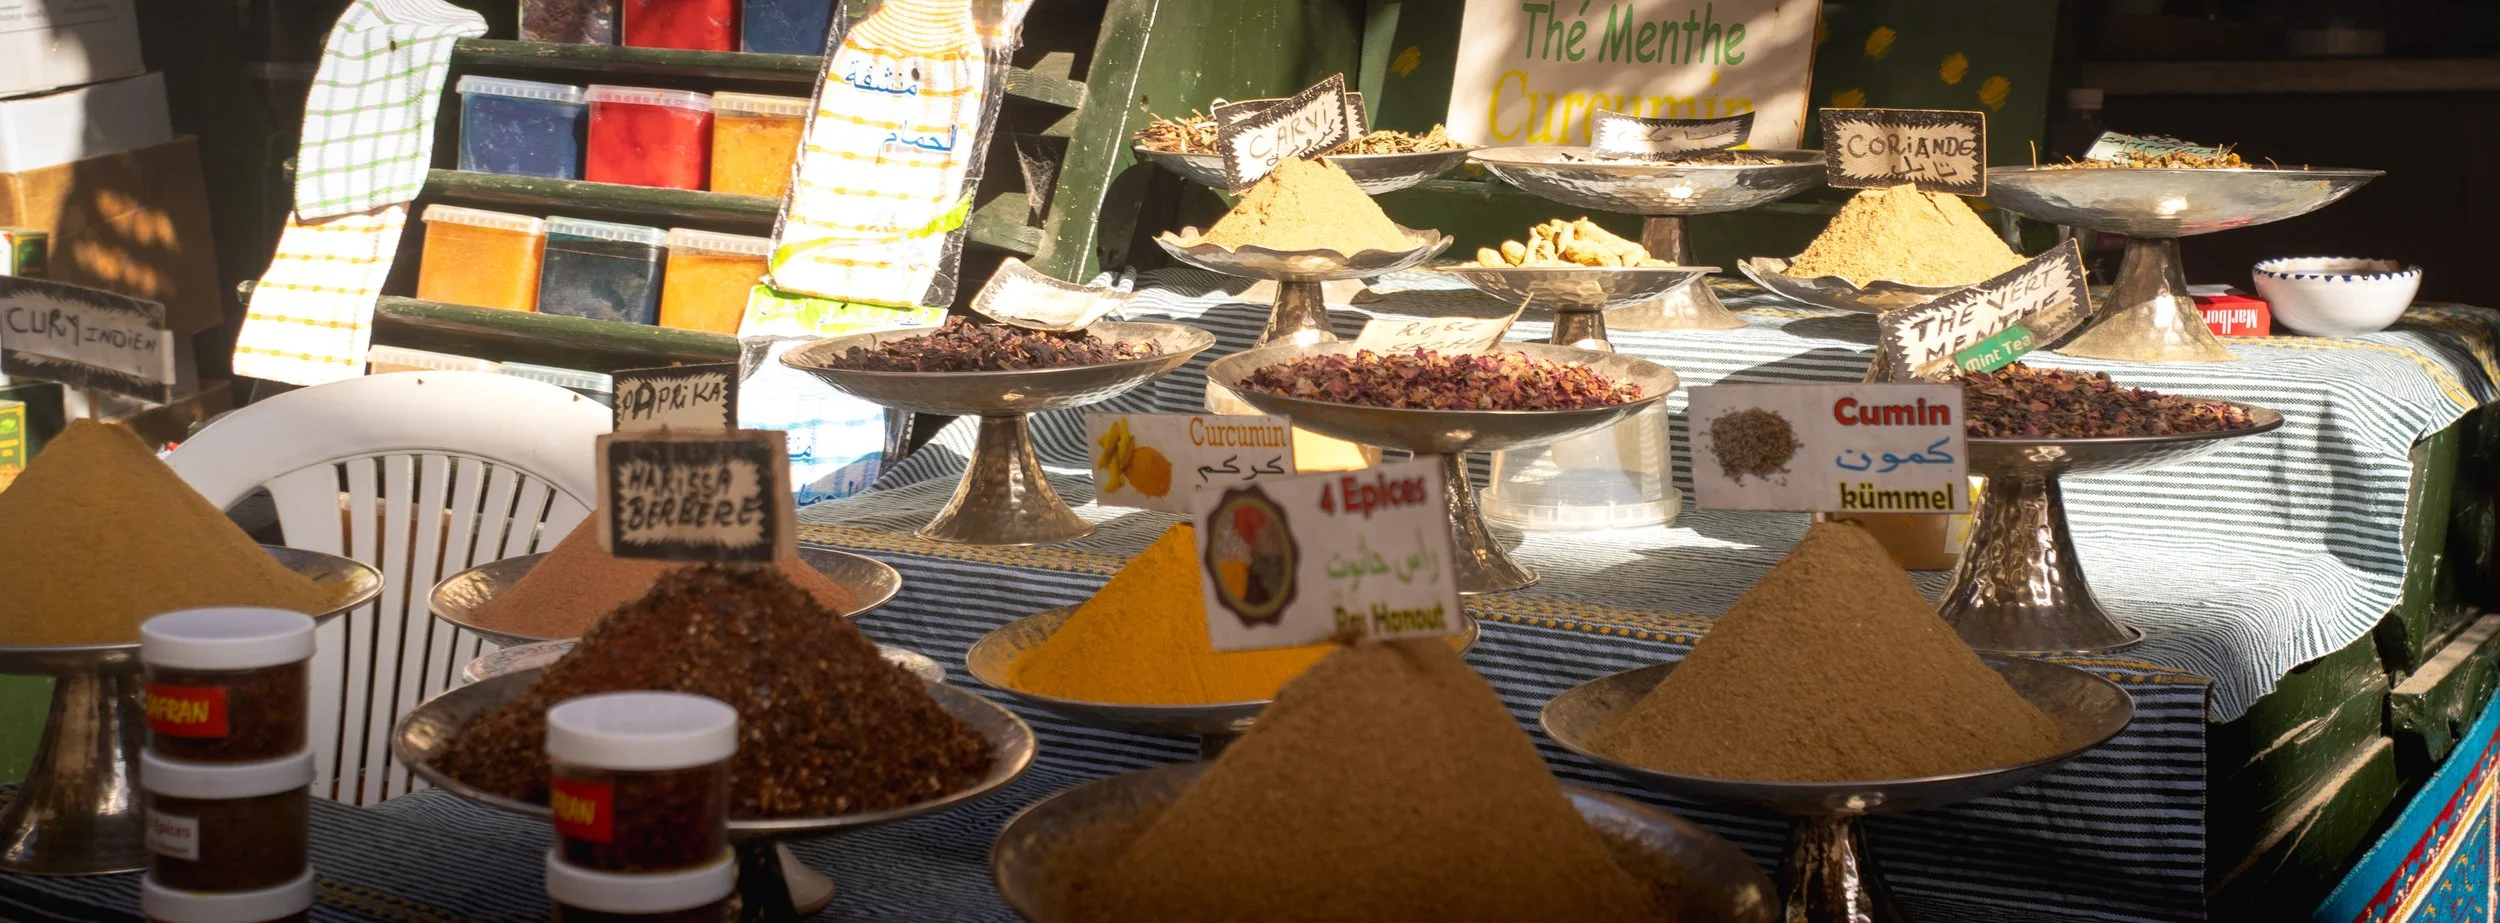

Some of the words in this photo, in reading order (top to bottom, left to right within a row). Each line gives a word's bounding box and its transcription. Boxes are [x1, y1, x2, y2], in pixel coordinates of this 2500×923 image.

[1522, 0, 1588, 62] Thé
[1599, 2, 1746, 66] Menthe
[845, 60, 918, 96] منشفة
[1987, 265, 2061, 311] VERT
[2199, 309, 2258, 334] Marlbor
[2002, 334, 2032, 357] Tea
[1834, 397, 1951, 426] Cumin
[1189, 417, 1288, 448] Curcumin
[1197, 455, 1286, 483] كركم
[1835, 436, 1954, 473] كمون
[1318, 482, 1337, 516] 4
[1340, 471, 1428, 520] Epices
[1840, 482, 1955, 511] kümmel
[1370, 600, 1447, 634] Hanout
[147, 693, 210, 725] AFRAN
